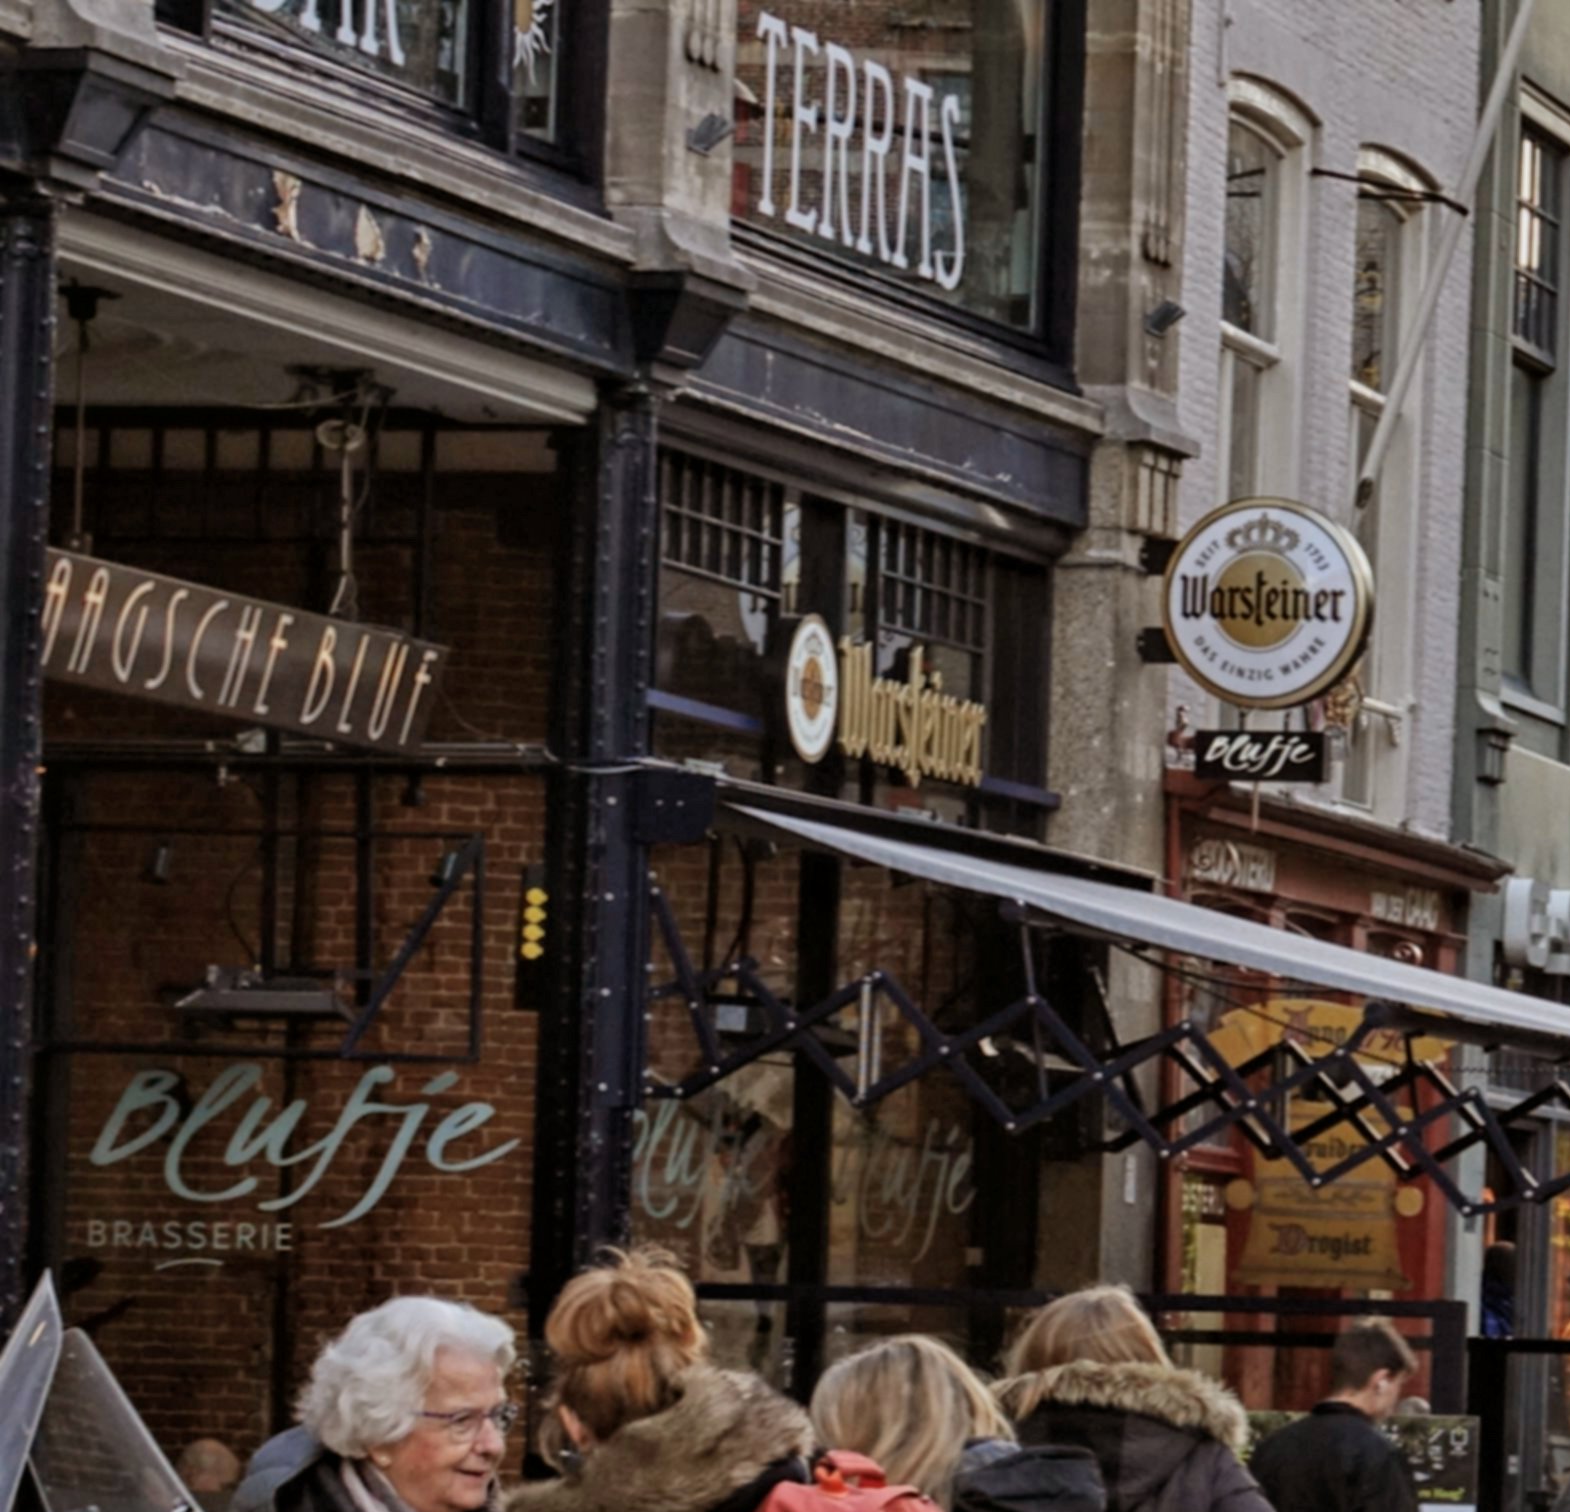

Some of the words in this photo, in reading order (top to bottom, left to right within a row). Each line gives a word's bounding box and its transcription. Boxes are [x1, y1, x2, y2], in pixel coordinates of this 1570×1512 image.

[757, 11, 965, 290] TERRAS
[1181, 571, 1346, 627] Warsteiner
[41, 558, 294, 716] AAGSCHE
[300, 625, 438, 746] BLUF
[1194, 635, 1217, 664] DAS
[1220, 660, 1275, 681] EINZIG
[1280, 637, 1326, 675] WAHRE
[1204, 734, 1316, 777] Blufje
[87, 1220, 293, 1251] BRASSERIE
